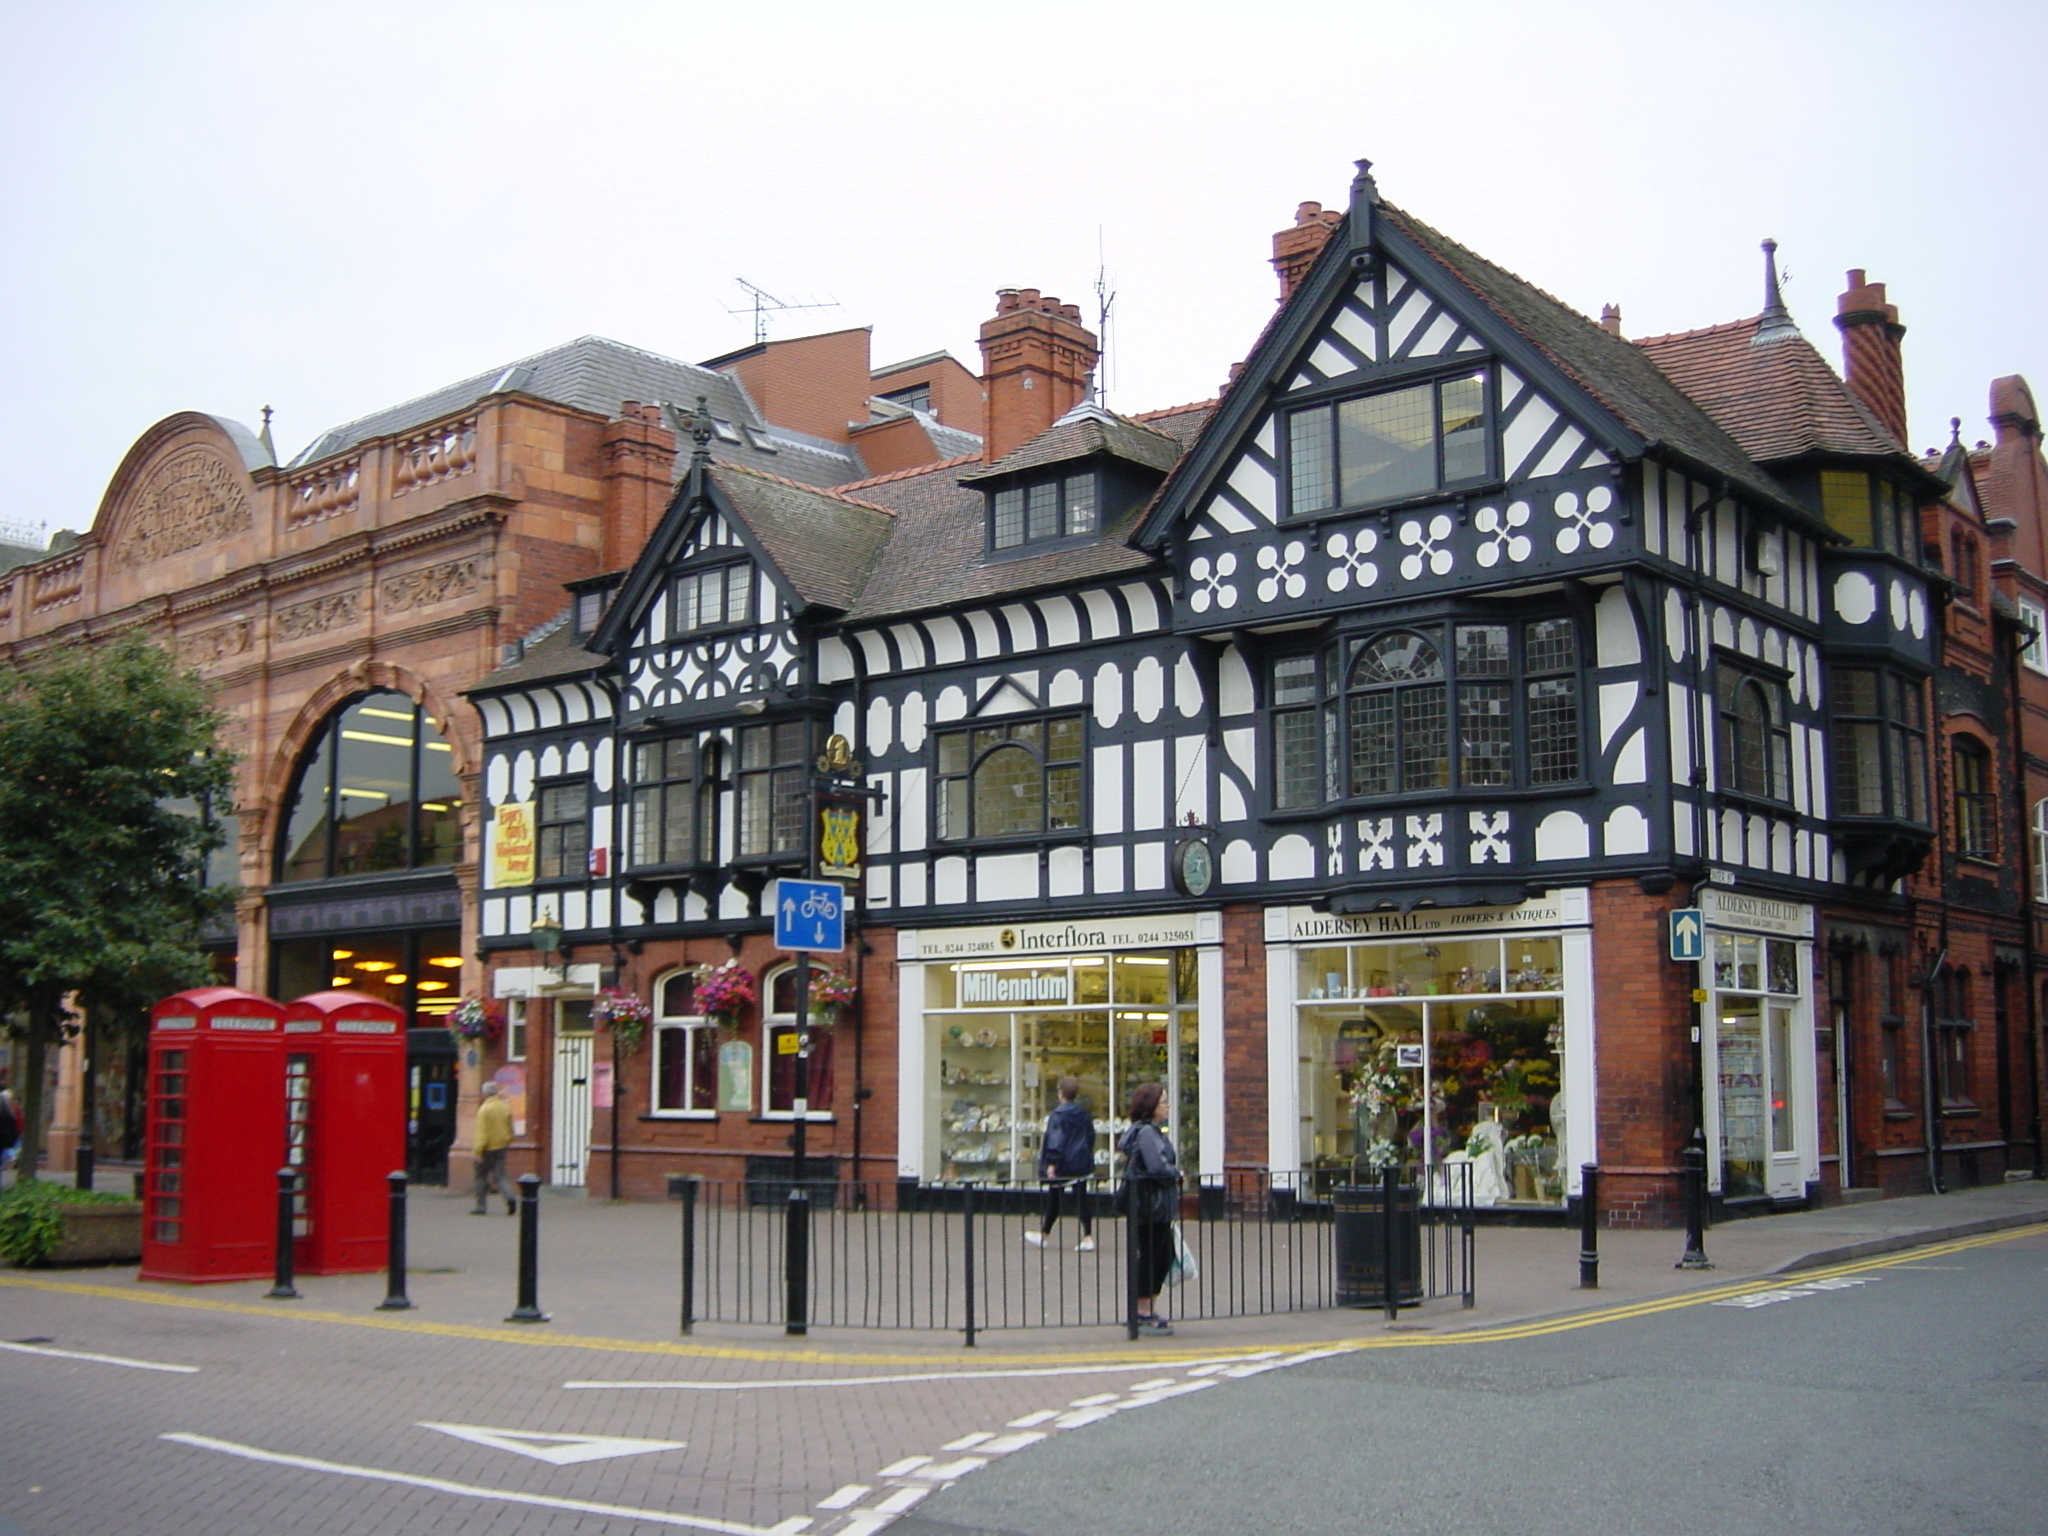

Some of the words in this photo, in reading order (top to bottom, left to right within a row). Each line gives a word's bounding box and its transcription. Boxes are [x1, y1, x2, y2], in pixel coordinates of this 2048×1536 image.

[1451, 912, 1494, 925] FLOWERS
[1497, 912, 1504, 922] &
[1508, 908, 1557, 921] ANTIQUES
[1716, 895, 1758, 915] ALDERSEY
[1760, 901, 1782, 919] HALL
[1783, 905, 1798, 921] LTD
[1020, 925, 1107, 949] Interflora
[1294, 917, 1372, 937] ALDERSEY
[1379, 915, 1422, 932] HALL
[1425, 921, 1440, 929] LTD
[922, 944, 942, 954] TEL.
[945, 943, 964, 953] 0244
[1111, 934, 1134, 945] TEL.
[1138, 932, 1159, 943] 0244
[1163, 930, 1194, 941] 325051
[963, 970, 1067, 1002] Millennium
